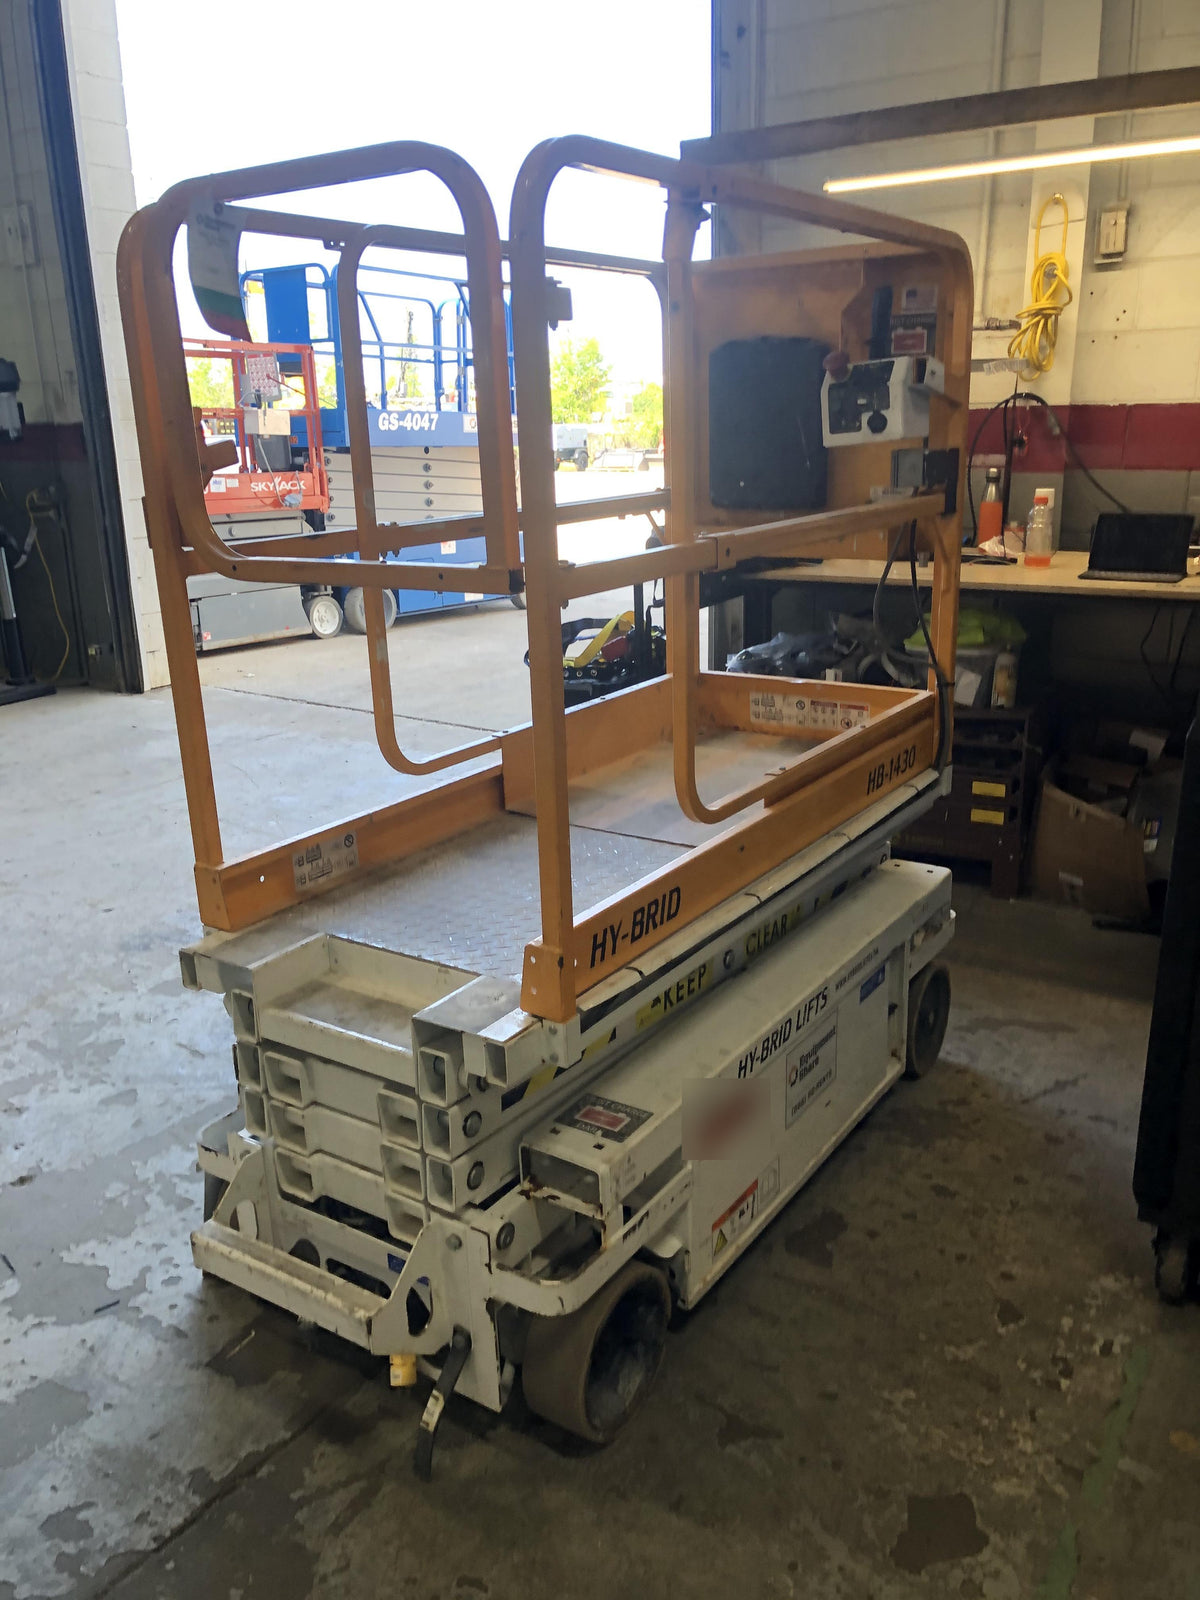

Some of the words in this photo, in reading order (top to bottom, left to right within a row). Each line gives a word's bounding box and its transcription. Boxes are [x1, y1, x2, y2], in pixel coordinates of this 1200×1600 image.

[378, 412, 439, 431] GS-4047
[250, 476, 307, 494] SKYJACK
[866, 745, 917, 795] HB-1430
[589, 886, 681, 969] HY-BRID
[663, 963, 707, 1012] KEEP
[746, 914, 788, 955] CLEAR
[737, 1018, 792, 1079] HY-BRID
[796, 986, 828, 1032] LIFTS
